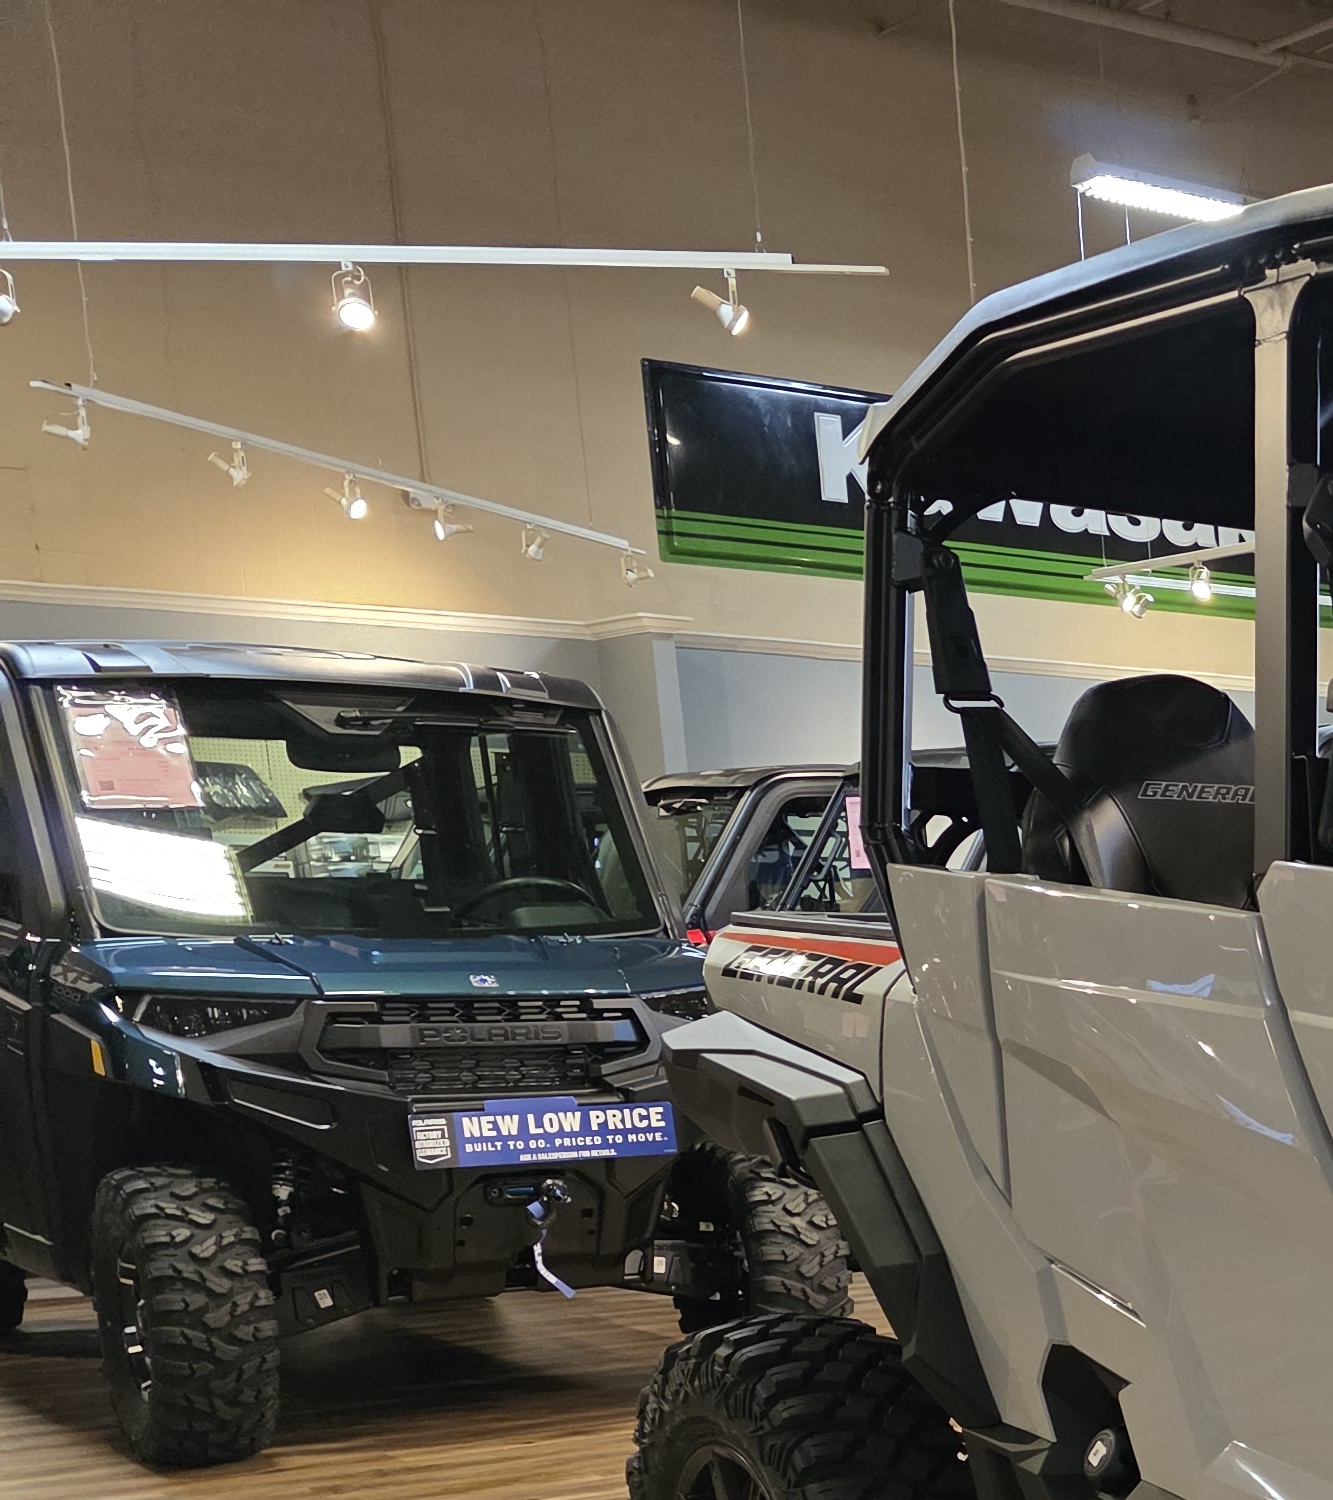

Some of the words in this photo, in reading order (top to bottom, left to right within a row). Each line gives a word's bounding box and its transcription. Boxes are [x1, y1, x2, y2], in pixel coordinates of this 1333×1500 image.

[418, 1025, 562, 1045] POLARIS
[461, 1114, 519, 1138] NEW
[527, 1111, 582, 1135] LOW
[589, 1106, 666, 1131] PRICE
[465, 1141, 503, 1153] BUILT
[507, 1140, 525, 1149] TO
[555, 1136, 602, 1147] PRICED
[607, 1134, 623, 1144] TO
[627, 1132, 669, 1143] MOVE.
